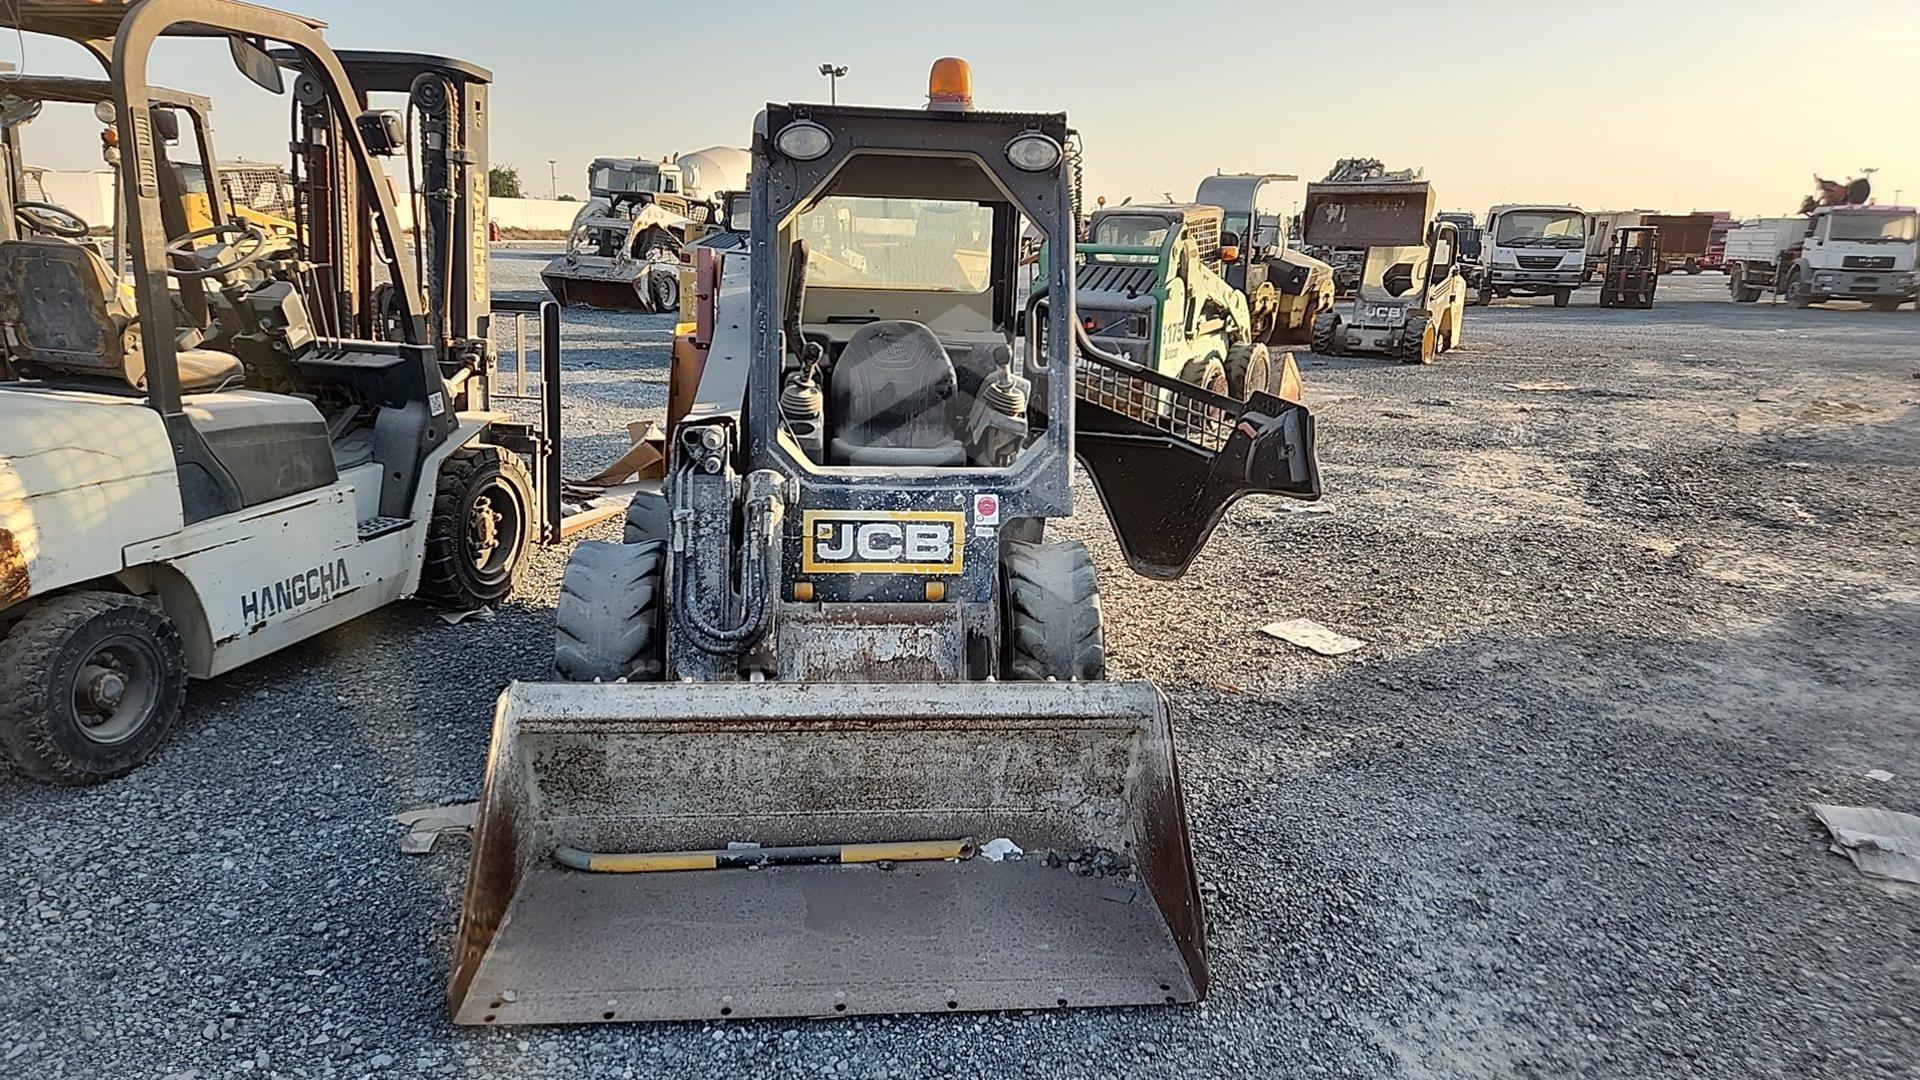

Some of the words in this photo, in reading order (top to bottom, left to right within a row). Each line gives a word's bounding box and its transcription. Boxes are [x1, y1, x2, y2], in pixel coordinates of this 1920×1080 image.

[1366, 306, 1401, 318] JCB
[816, 523, 952, 561] JCB
[241, 557, 350, 626] HANGCHA
